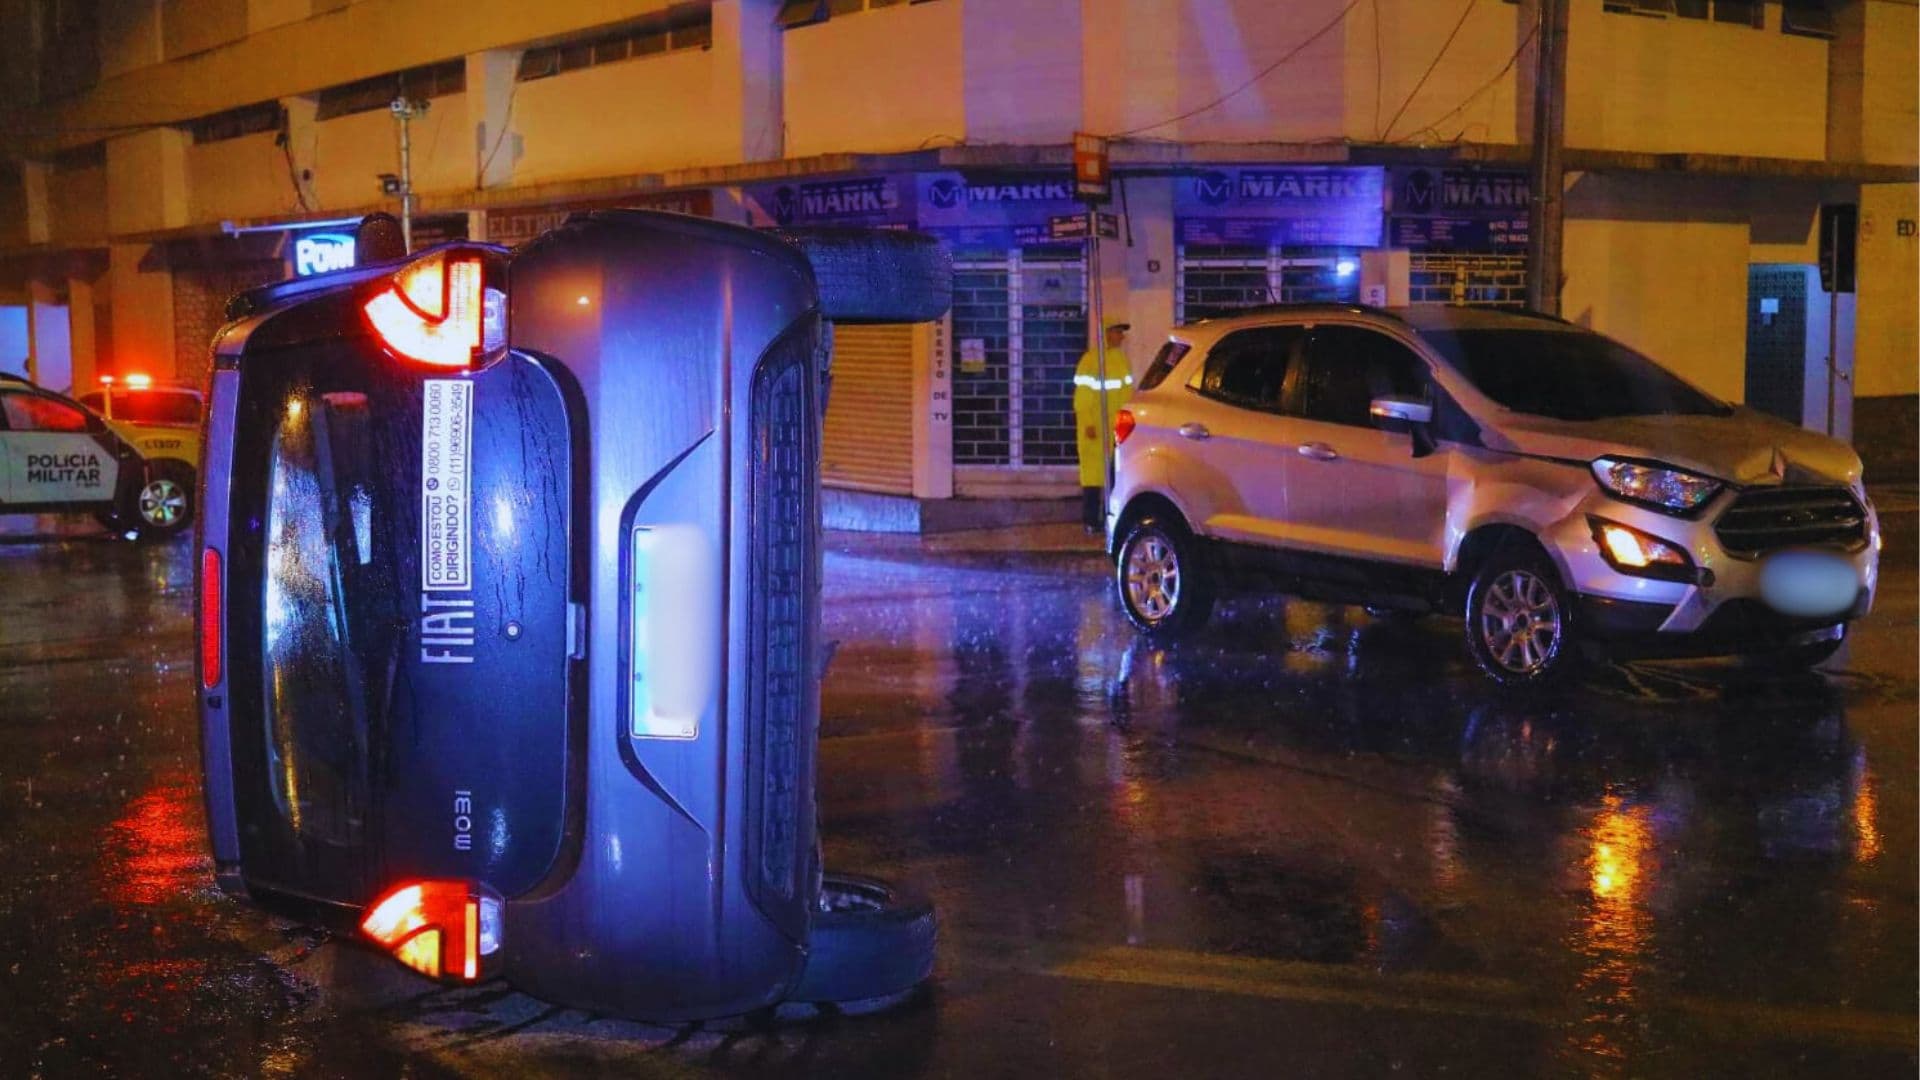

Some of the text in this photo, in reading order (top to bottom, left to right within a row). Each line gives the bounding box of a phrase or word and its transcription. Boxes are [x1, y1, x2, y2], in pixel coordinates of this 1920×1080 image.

[802, 184, 898, 214] MARKS
[968, 183, 1073, 200] MARK
[1241, 174, 1374, 198] MARK
[1444, 177, 1530, 206] MARK
[933, 318, 948, 421] NSERTO DE TV
[428, 417, 441, 439] 713
[428, 441, 441, 475] 0800
[28, 469, 100, 483] MILITAR
[446, 495, 460, 581] DIRIGINDO?
[421, 593, 475, 663] FIAT
[454, 790, 471, 850] MOBI
